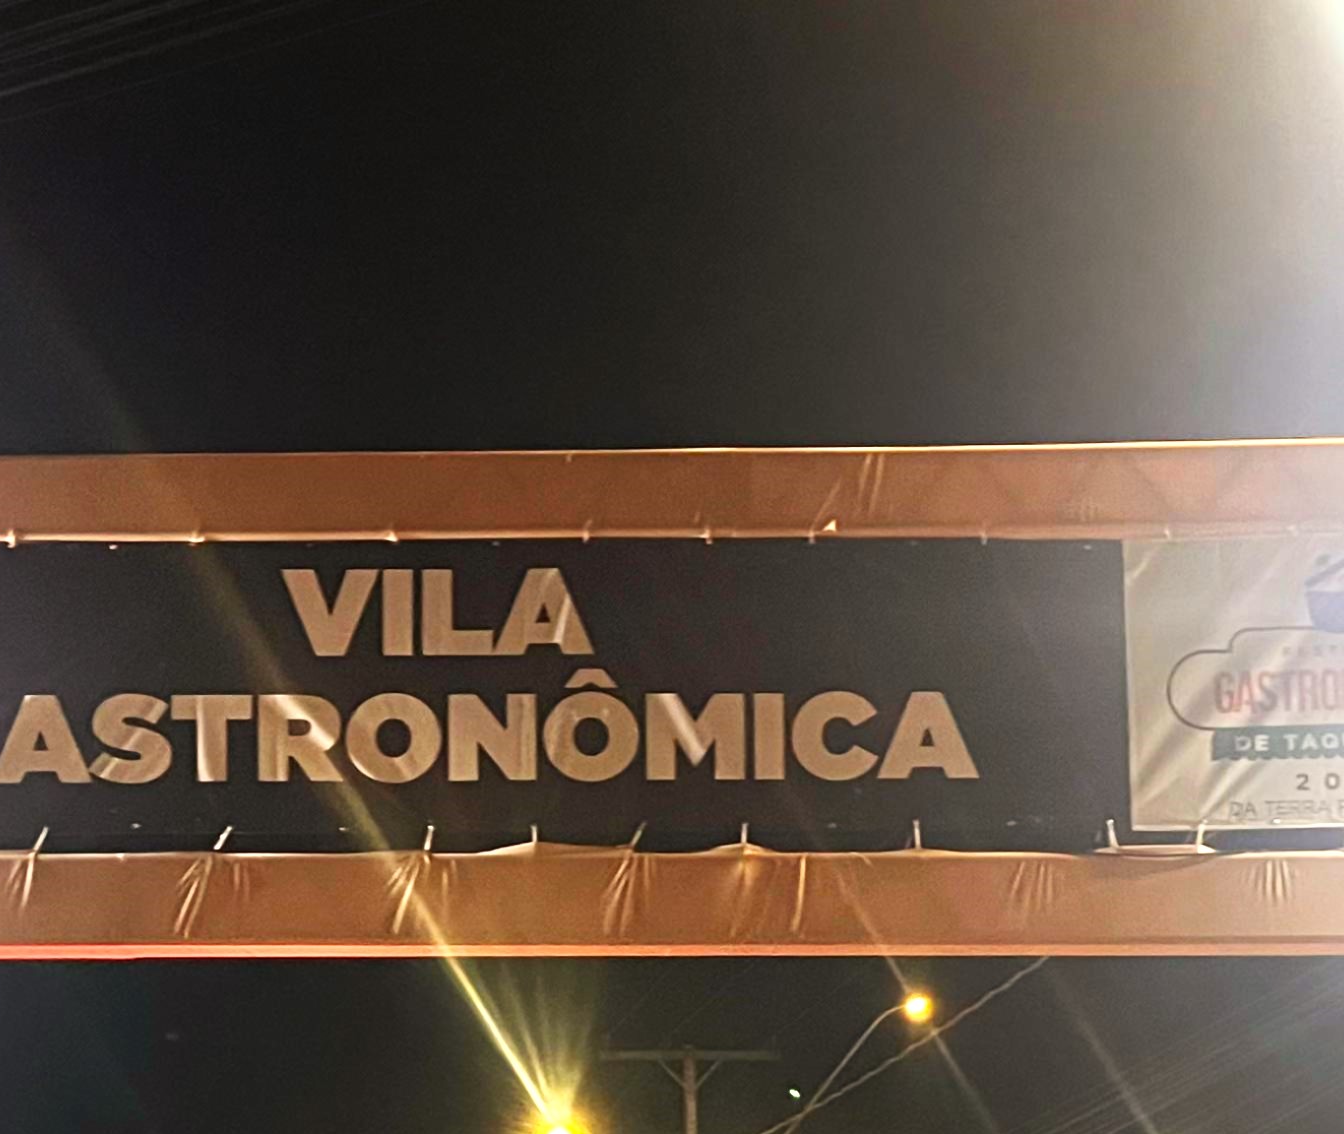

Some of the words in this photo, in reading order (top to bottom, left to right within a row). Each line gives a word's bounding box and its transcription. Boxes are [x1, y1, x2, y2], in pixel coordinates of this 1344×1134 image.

[282, 566, 594, 658] VILA
[1235, 732, 1269, 752] DE
[1229, 800, 1257, 818] DA
[1264, 798, 1331, 817] TERRA
